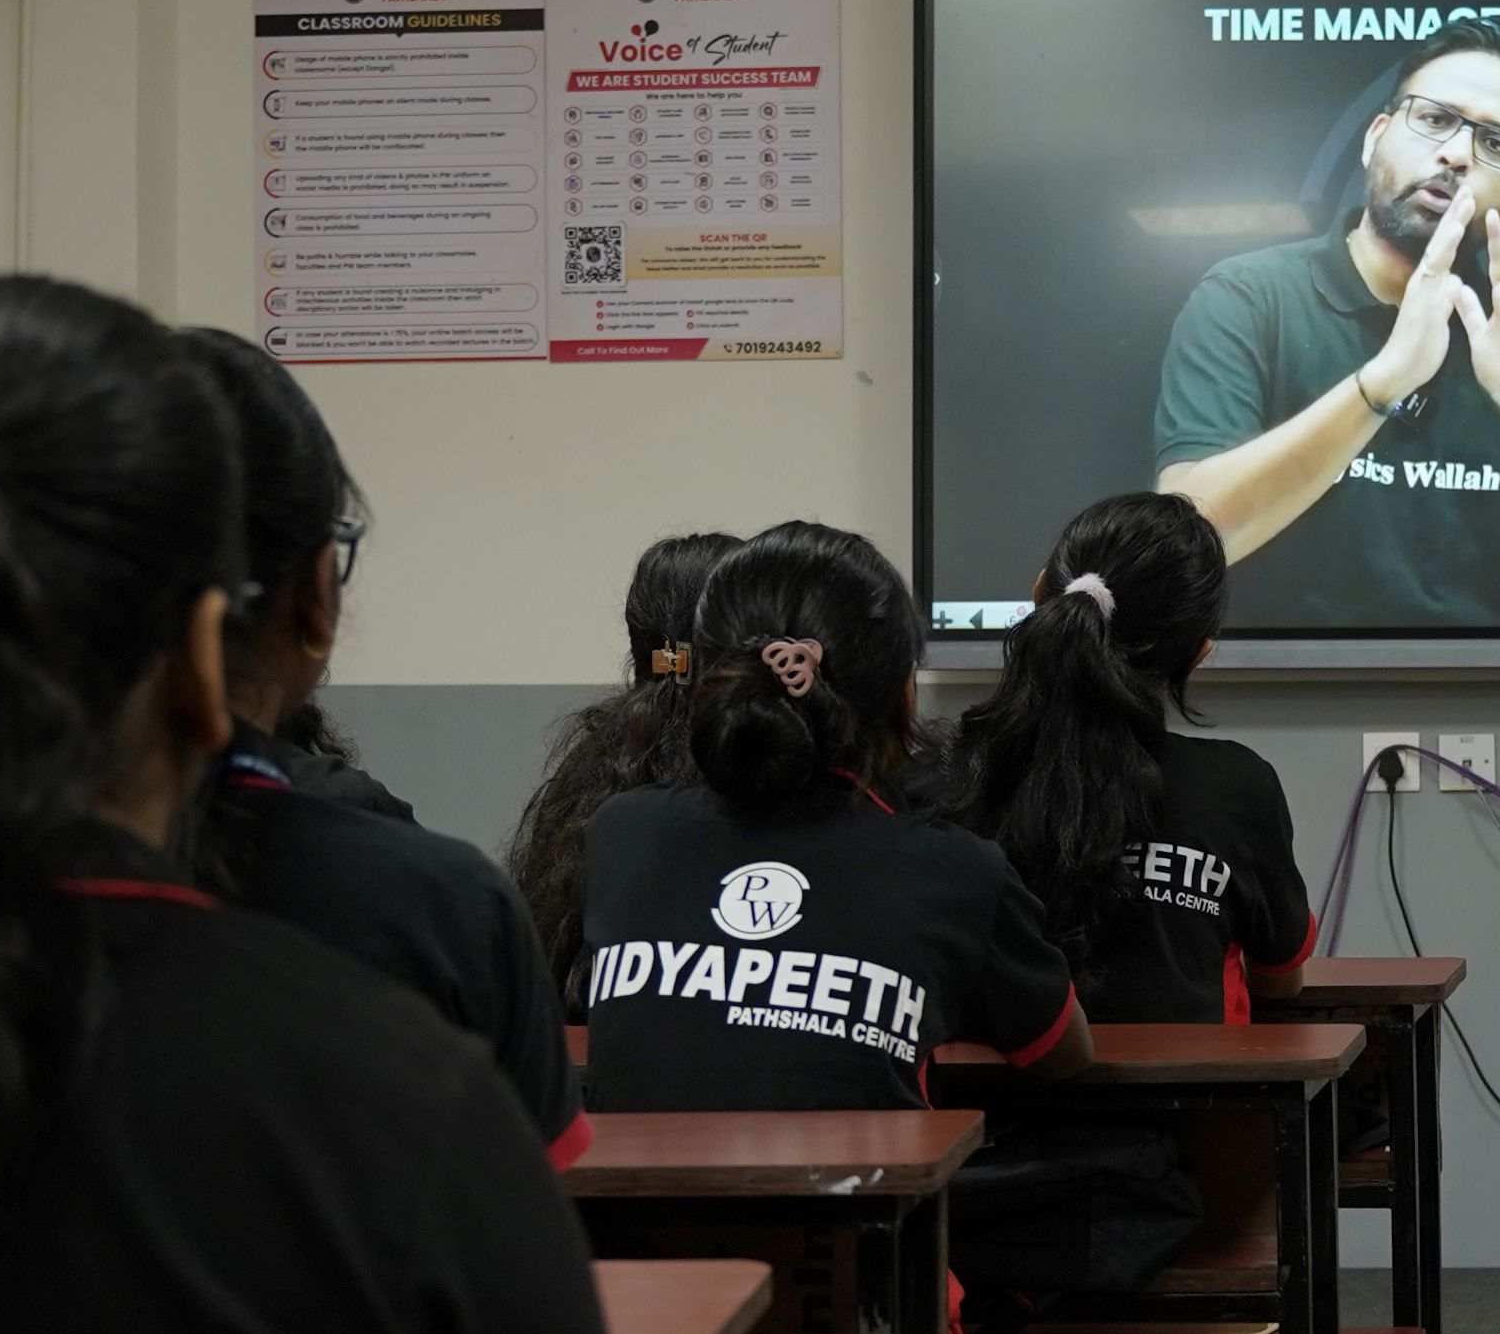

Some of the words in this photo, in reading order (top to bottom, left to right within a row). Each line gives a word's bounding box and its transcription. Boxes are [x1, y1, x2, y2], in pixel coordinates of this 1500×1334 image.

[298, 15, 403, 30] CLASSROOM
[407, 14, 502, 28] GUIDELINES
[1204, 8, 1303, 41] TIME
[599, 37, 683, 63] Voice
[705, 32, 787, 65] Student
[576, 75, 599, 88] WE
[603, 75, 630, 87] ARE
[633, 73, 698, 86] STUDENT
[702, 72, 768, 85] SUCCESS
[771, 71, 812, 83] TEAM
[699, 233, 728, 243] SCAN
[731, 233, 749, 243] THE
[752, 233, 767, 243] QR
[736, 341, 821, 355] 7019243492
[1403, 460, 1500, 491] Wallah
[1175, 891, 1220, 916] CENTRE
[727, 1005, 847, 1038] PATHSHALA
[851, 1022, 917, 1063] CENTRE
